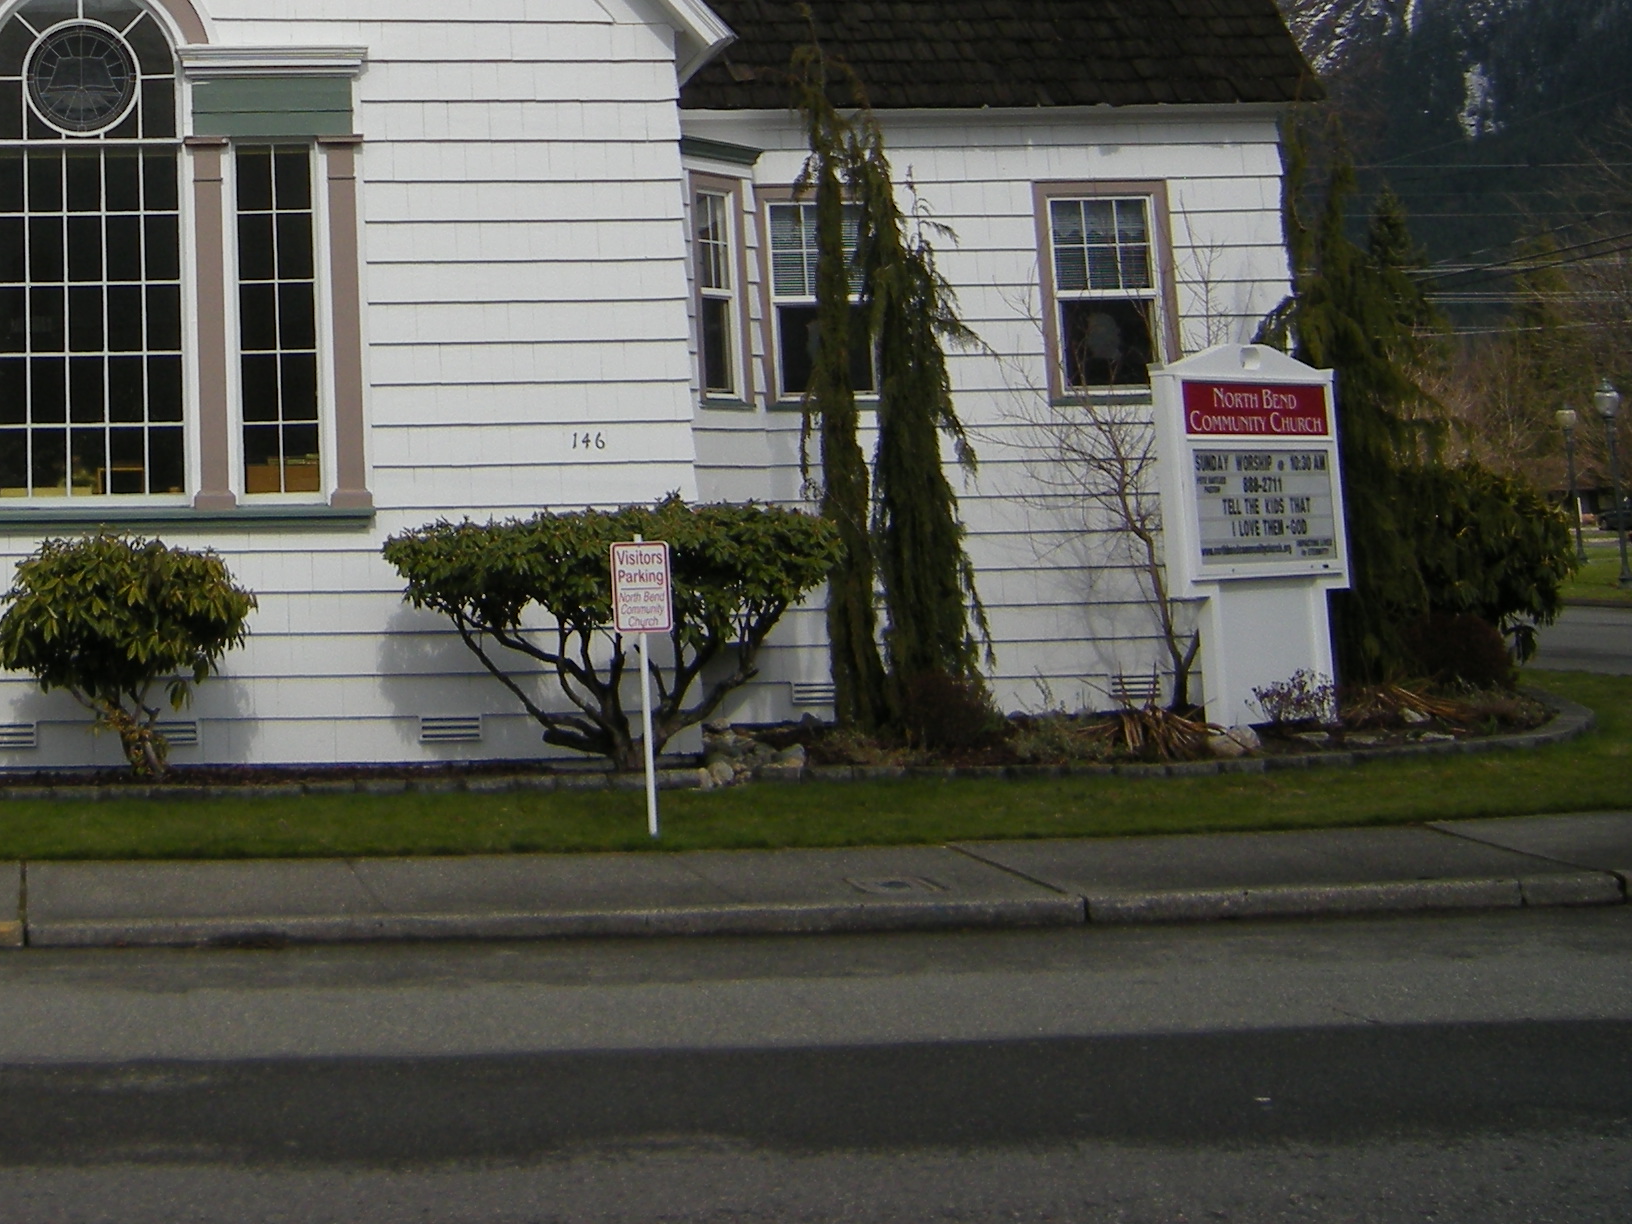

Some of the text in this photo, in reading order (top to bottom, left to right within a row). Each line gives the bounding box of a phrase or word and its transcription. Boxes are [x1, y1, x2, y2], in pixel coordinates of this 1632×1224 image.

[572, 432, 605, 449] 146
[1195, 454, 1228, 471] SUNDAY
[1236, 455, 1272, 471] WORSHIP
[1290, 455, 1311, 471] 10:30
[1314, 455, 1326, 471] AM
[1243, 478, 1282, 493] 888-2711
[1222, 497, 1310, 515] TELL THE KIDS THAT
[1238, 520, 1260, 536] LOVE
[1262, 519, 1284, 535] THEM
[617, 550, 662, 565] Visitors
[618, 570, 663, 585] Parking
[619, 592, 664, 602] North Bend
[621, 604, 664, 615] Community
[628, 616, 658, 627] Church
